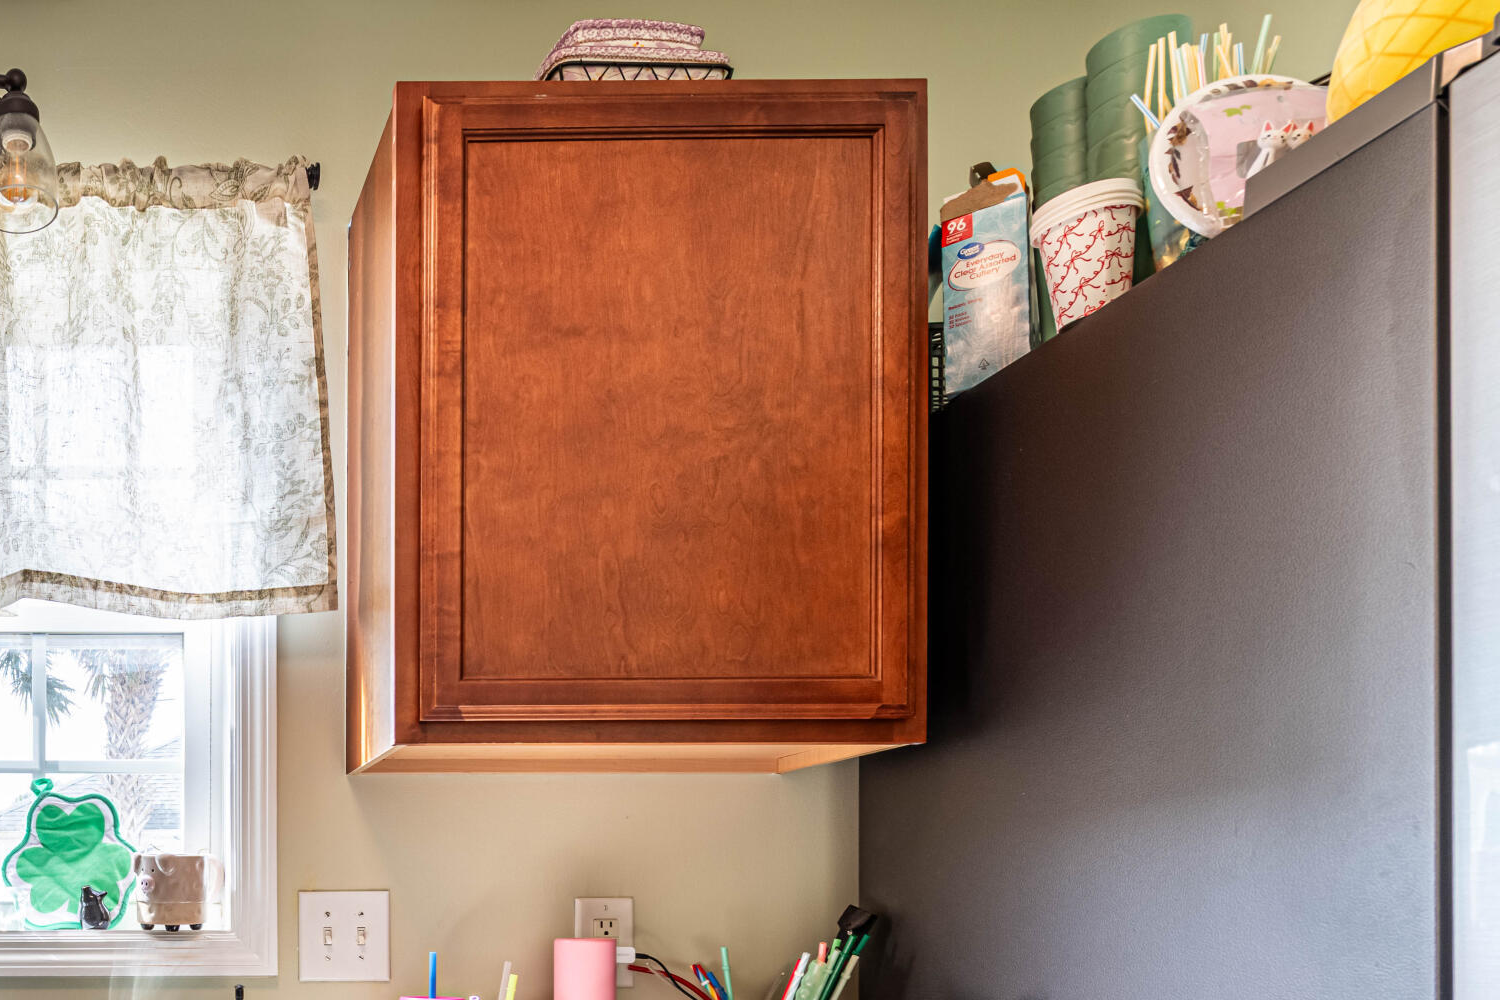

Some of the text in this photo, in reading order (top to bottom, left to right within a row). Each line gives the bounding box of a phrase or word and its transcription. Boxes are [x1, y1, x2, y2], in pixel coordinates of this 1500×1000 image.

[947, 218, 966, 234] 96
[954, 253, 1016, 279] Clear Assorted
[966, 252, 1004, 268] Everyday
[969, 266, 1000, 280] Cutlery
